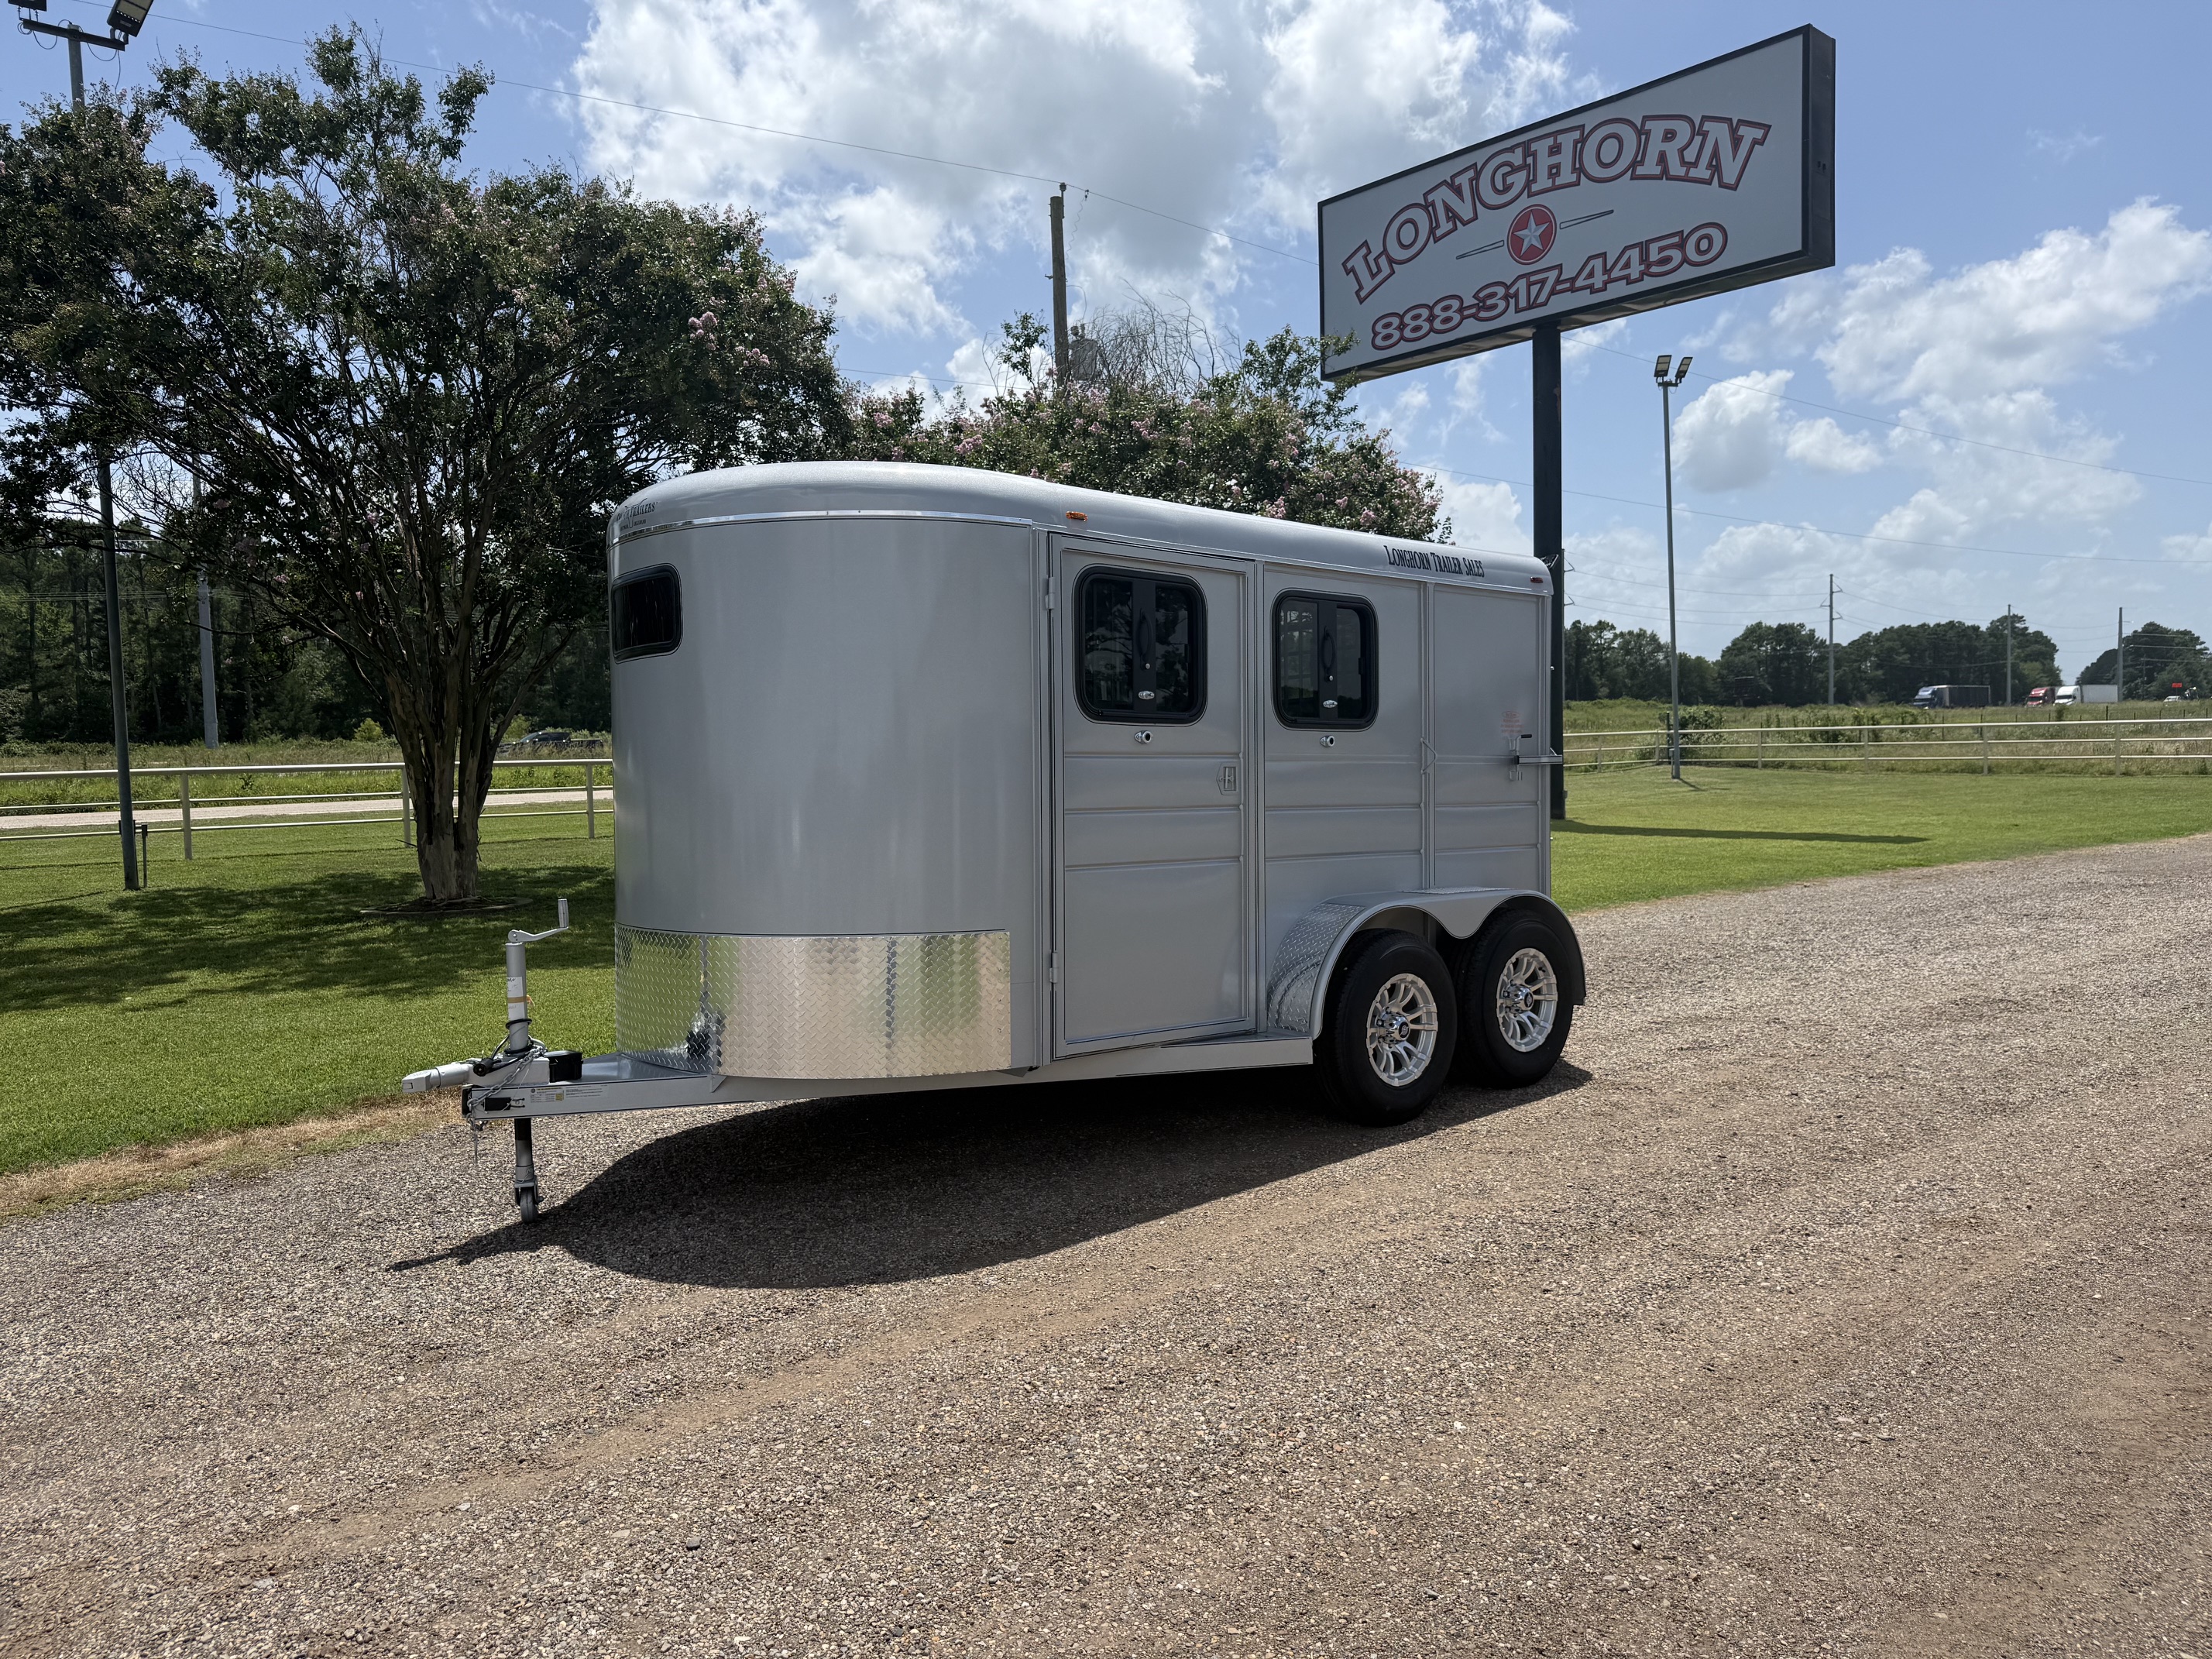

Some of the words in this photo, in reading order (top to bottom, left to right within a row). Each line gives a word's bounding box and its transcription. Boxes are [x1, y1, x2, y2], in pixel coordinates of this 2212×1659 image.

[1342, 115, 1771, 304] LONGHORN
[1372, 222, 1728, 351] 888-317-4450
[1383, 545, 1431, 570] LONGHORN
[1431, 552, 1463, 575] TRAILER
[1463, 557, 1485, 578] SALES
